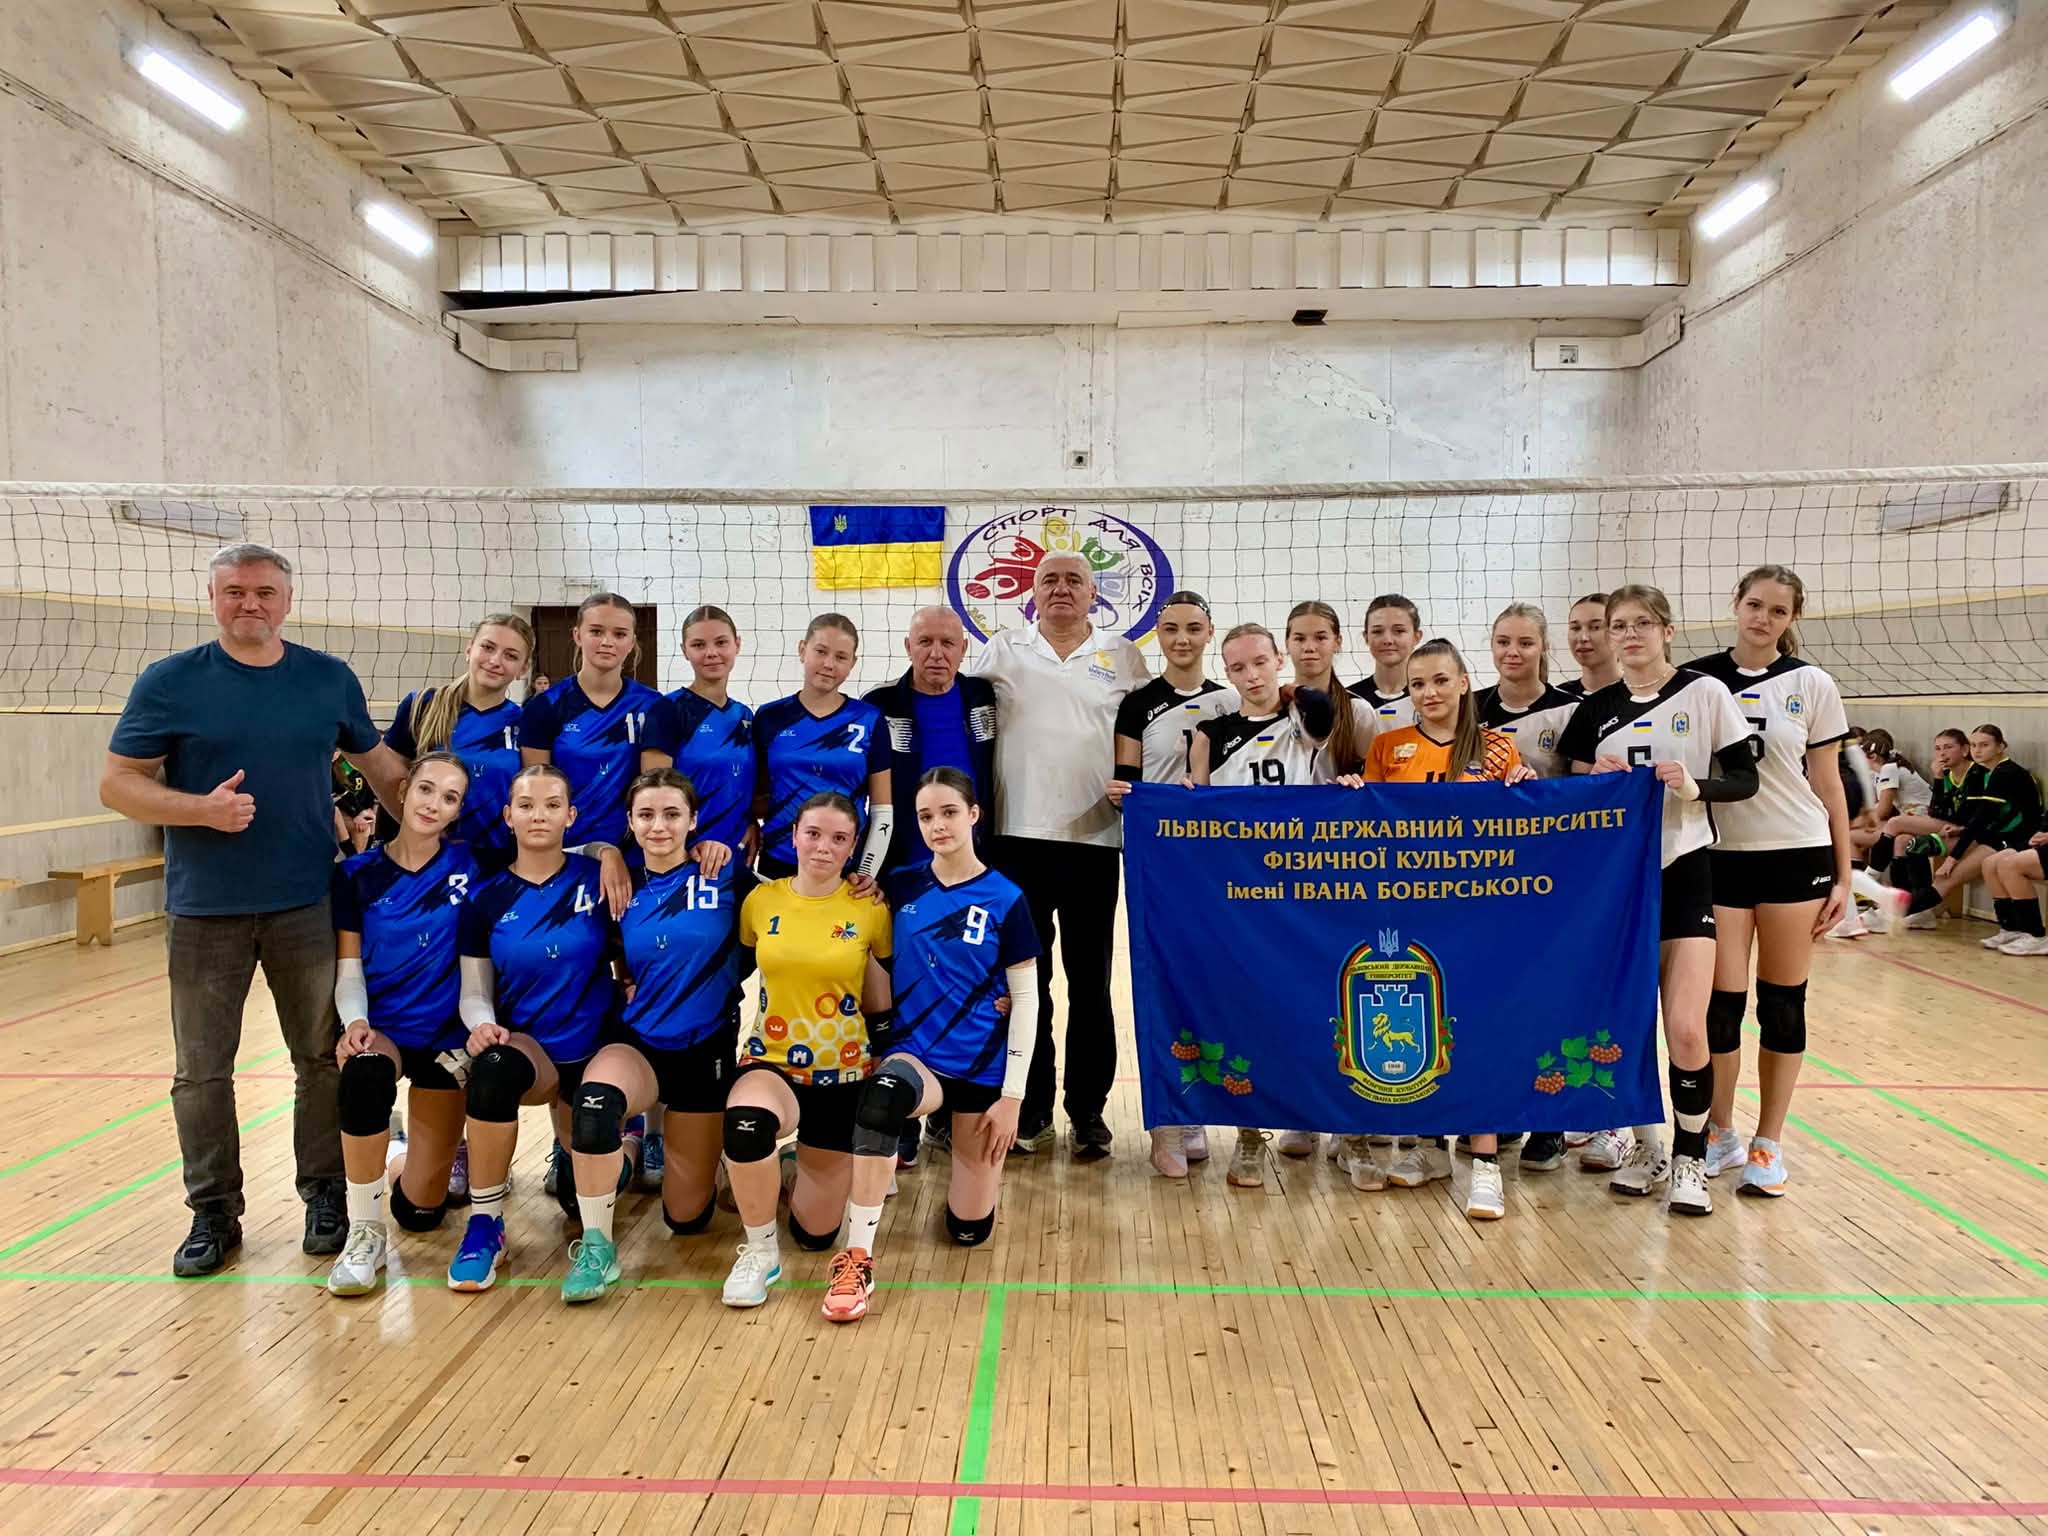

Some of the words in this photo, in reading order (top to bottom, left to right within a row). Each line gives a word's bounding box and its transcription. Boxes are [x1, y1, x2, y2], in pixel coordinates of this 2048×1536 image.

[983, 507, 1076, 541] СПОРТ
[1132, 563, 1153, 612] ВСІХ
[847, 723, 865, 753] 2
[1248, 759, 1286, 786] 19
[1156, 817, 1304, 840] ЛЬВІВСЬКИЙ
[1312, 815, 1463, 843] ДЕРЖАВНИЙ
[1472, 808, 1627, 837] УНІВЕРСИТЕТ
[1263, 847, 1387, 870] ФІЗИЧНОЇ
[1396, 849, 1515, 869] КУЛЬТУРИ
[449, 873, 468, 906] 3
[574, 884, 595, 916] 4
[686, 874, 719, 910] 15
[1226, 881, 1284, 899] імені
[1294, 881, 1368, 900] ІВАНА
[1377, 875, 1553, 900] БОБЕРСЬКОГО
[767, 915, 781, 935] 1
[962, 905, 989, 945] 9
